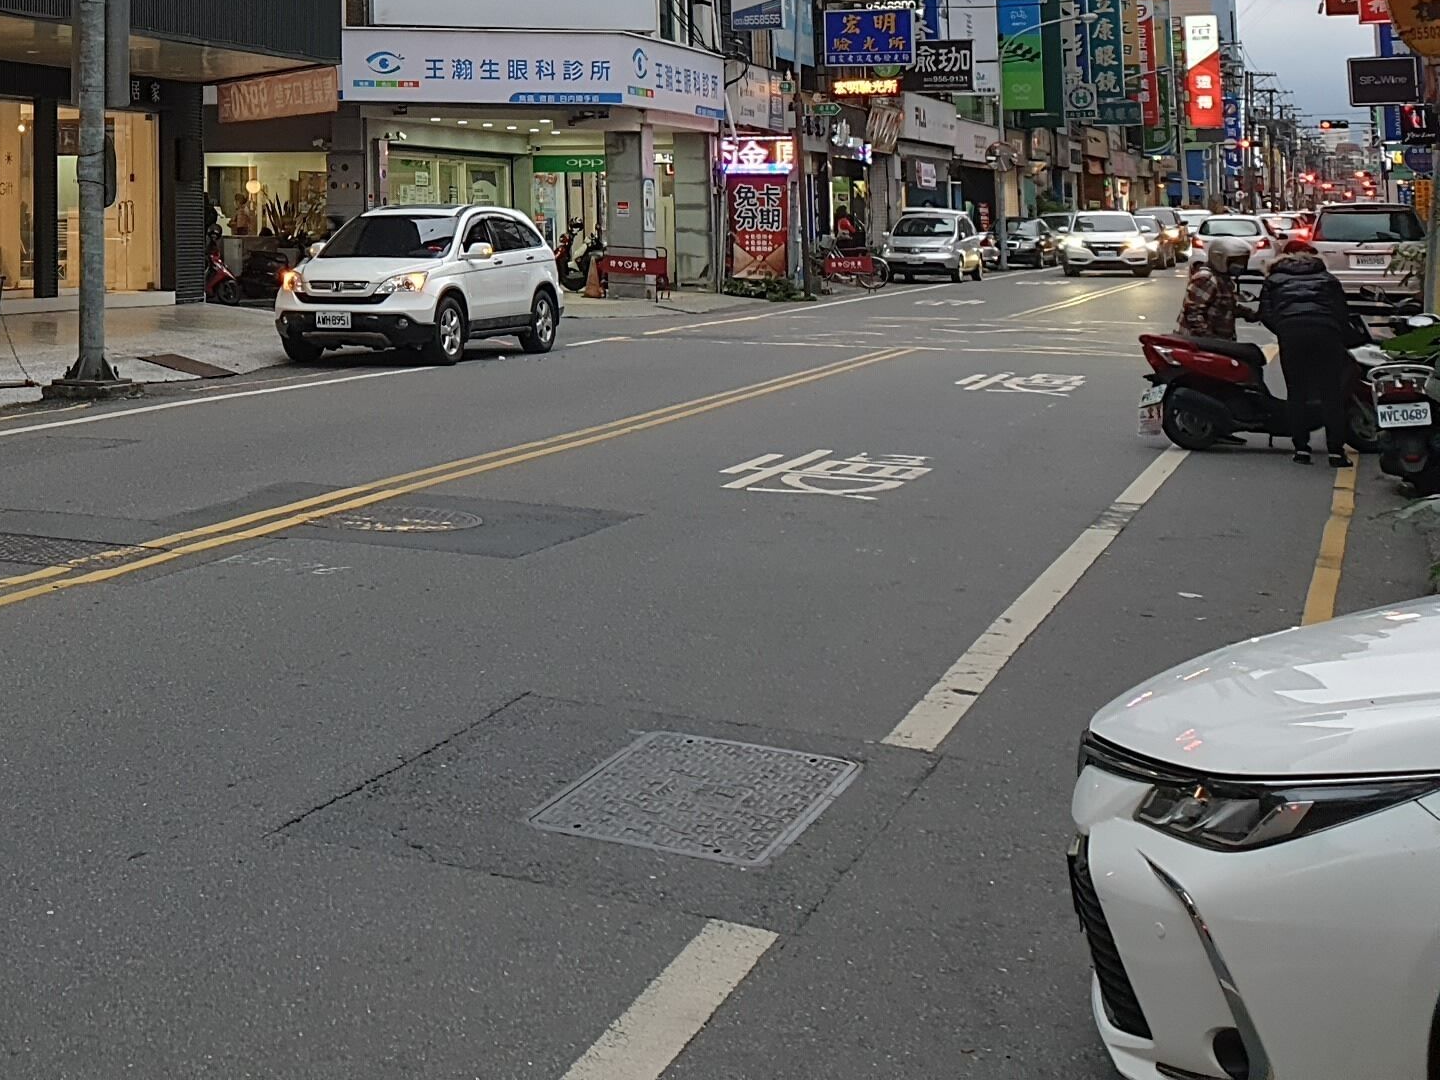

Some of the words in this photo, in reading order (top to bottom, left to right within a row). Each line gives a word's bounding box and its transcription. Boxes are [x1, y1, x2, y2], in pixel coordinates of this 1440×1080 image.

[841, 12, 897, 34] 宏明
[425, 58, 611, 81] 王瀚生眼科診所
[655, 62, 719, 99] 王瀚生眼科診所
[734, 184, 781, 207] 免卡
[735, 207, 781, 231] 分期
